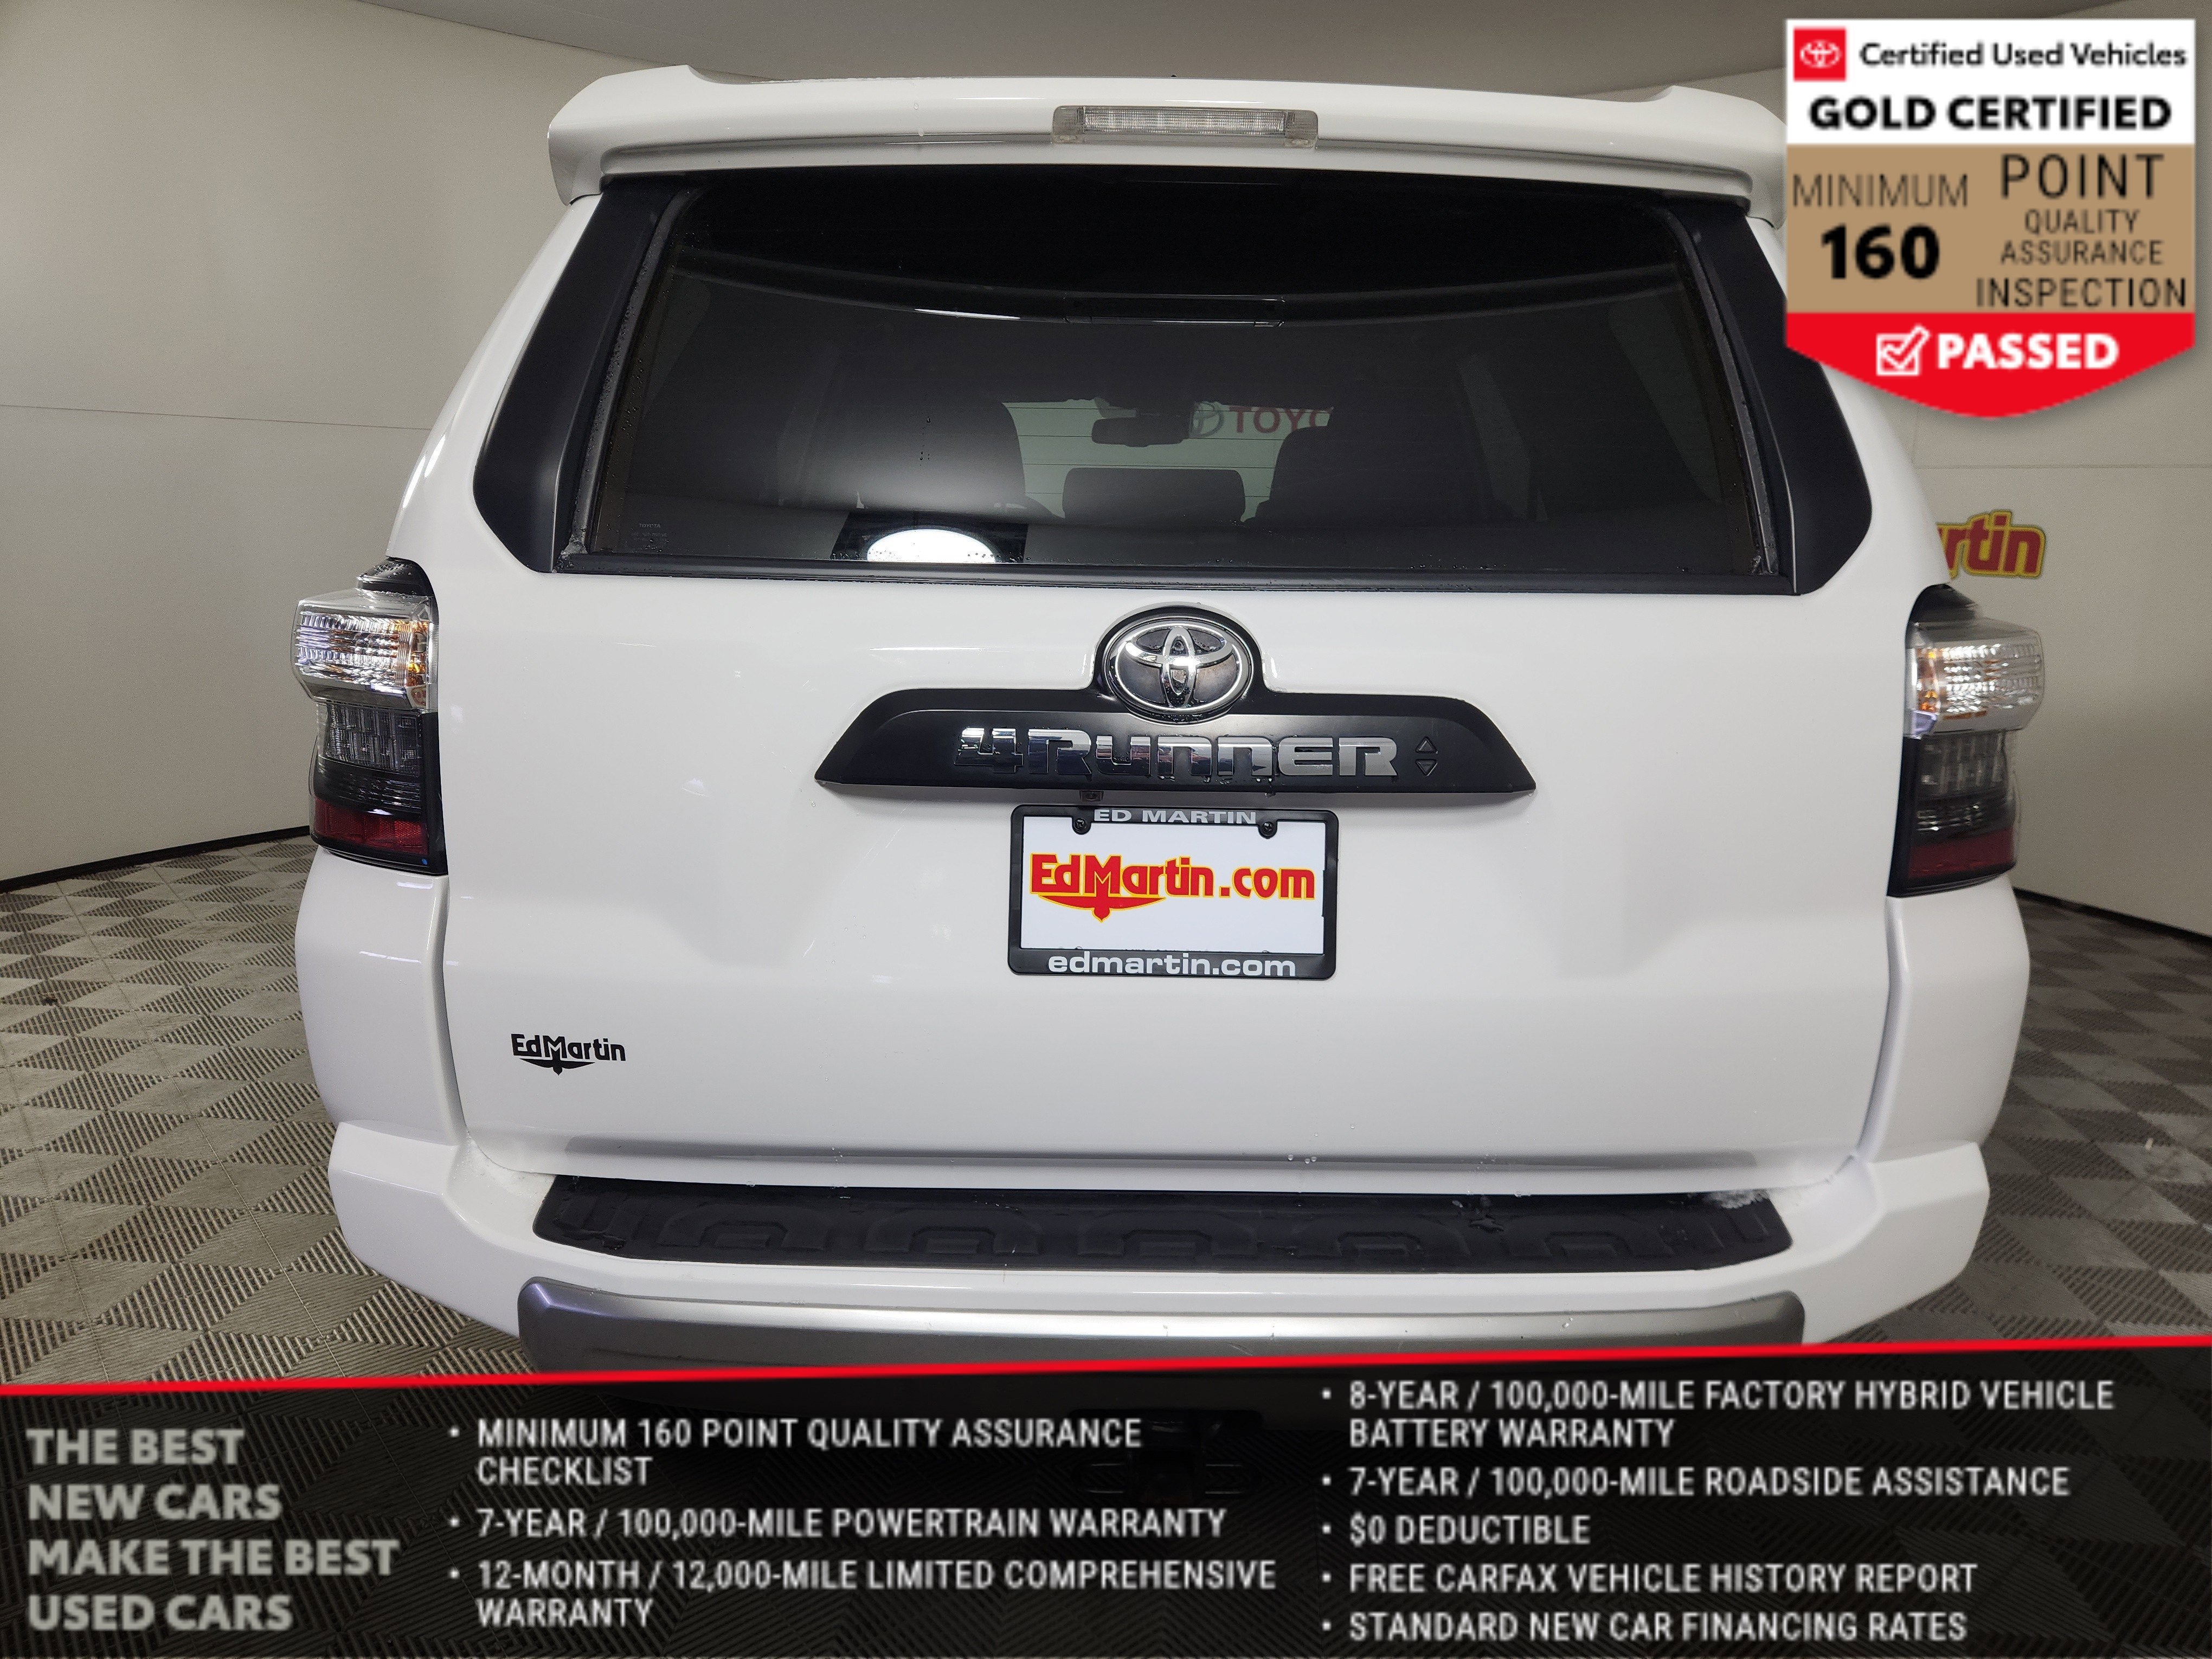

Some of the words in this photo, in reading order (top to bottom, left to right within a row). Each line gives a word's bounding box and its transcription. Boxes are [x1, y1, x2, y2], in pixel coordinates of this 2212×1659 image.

[1093, 808, 1131, 822] ED
[1142, 810, 1256, 825] MARTIN
[1048, 950, 1296, 978] edmartin.com
